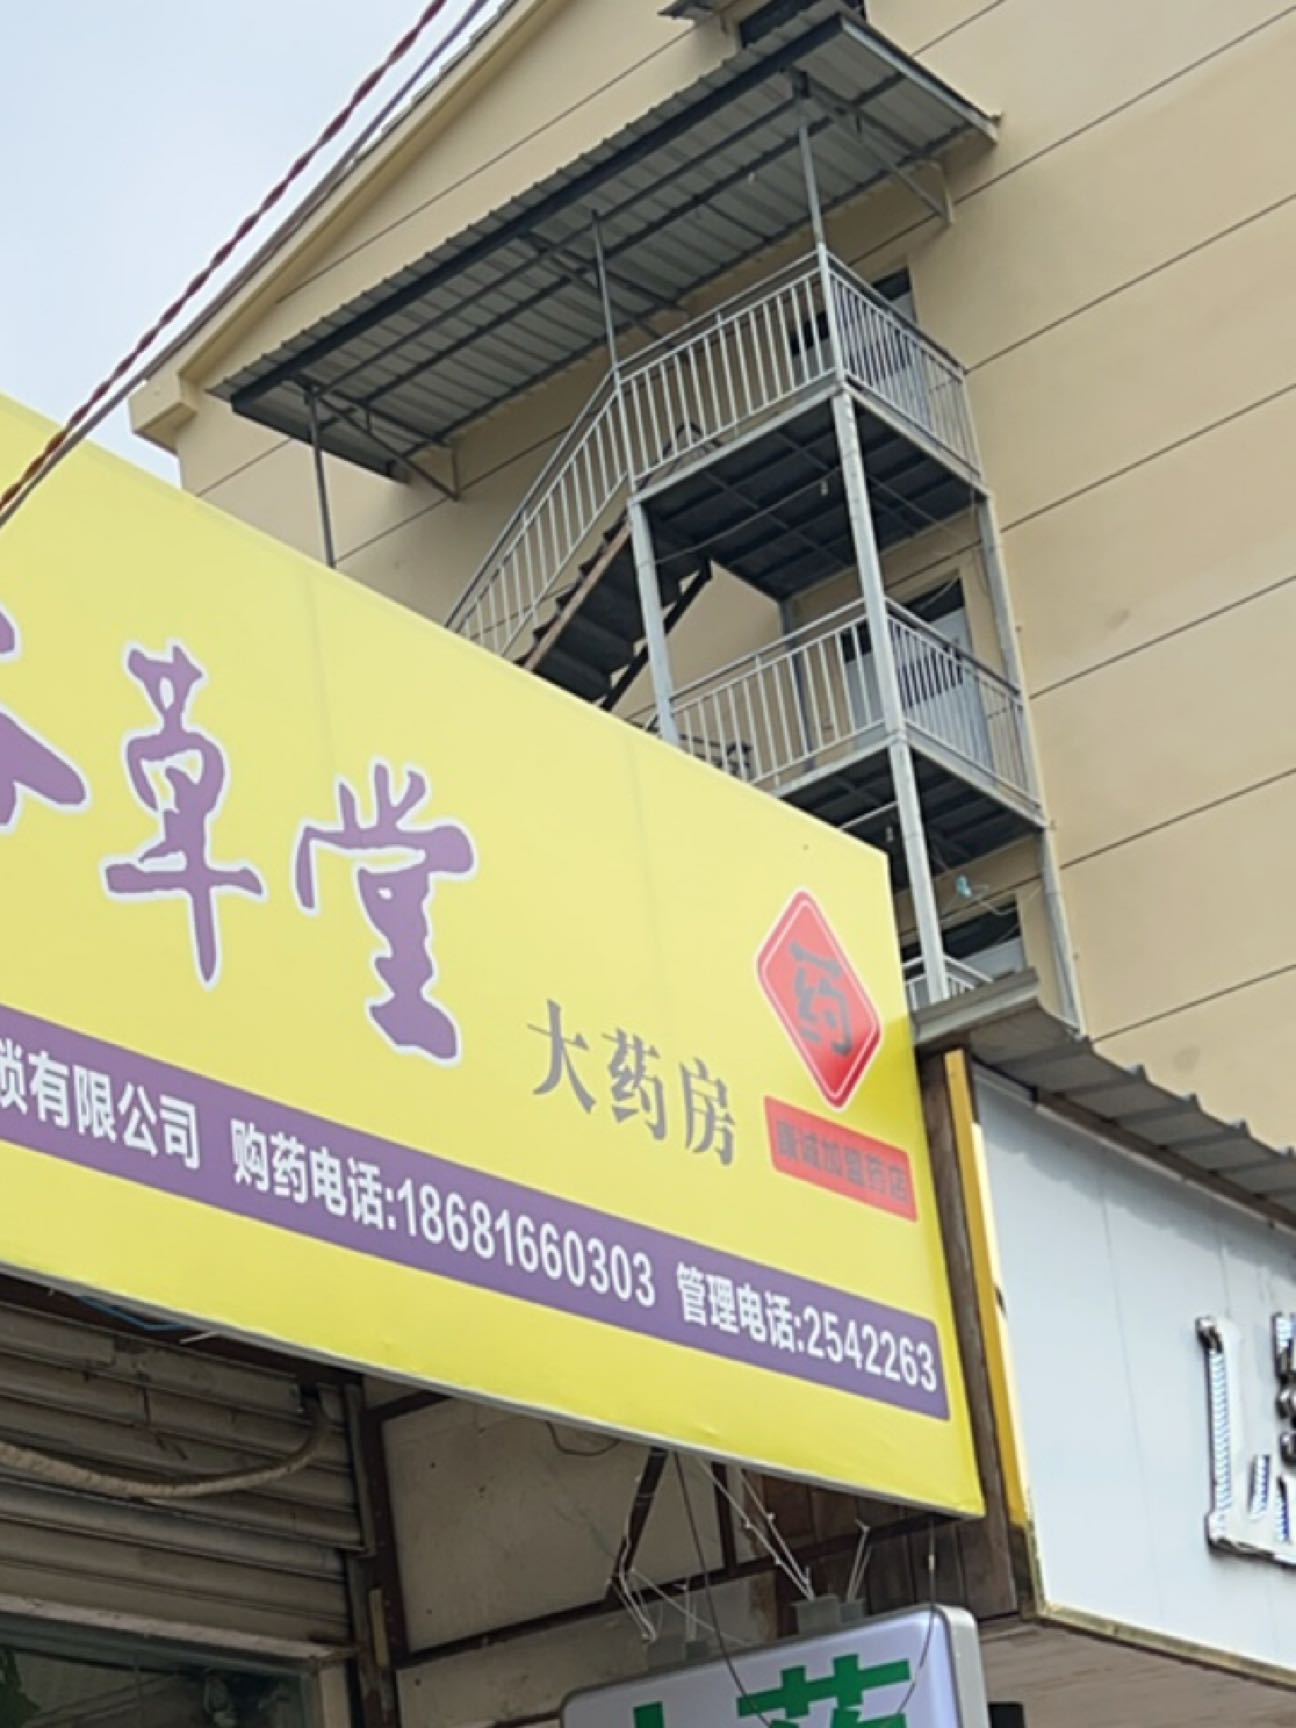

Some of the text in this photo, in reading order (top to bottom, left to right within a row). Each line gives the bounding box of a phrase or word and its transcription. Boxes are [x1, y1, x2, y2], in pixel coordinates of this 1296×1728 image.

[790, 939, 851, 1055] 药
[527, 999, 737, 1165] 大药房
